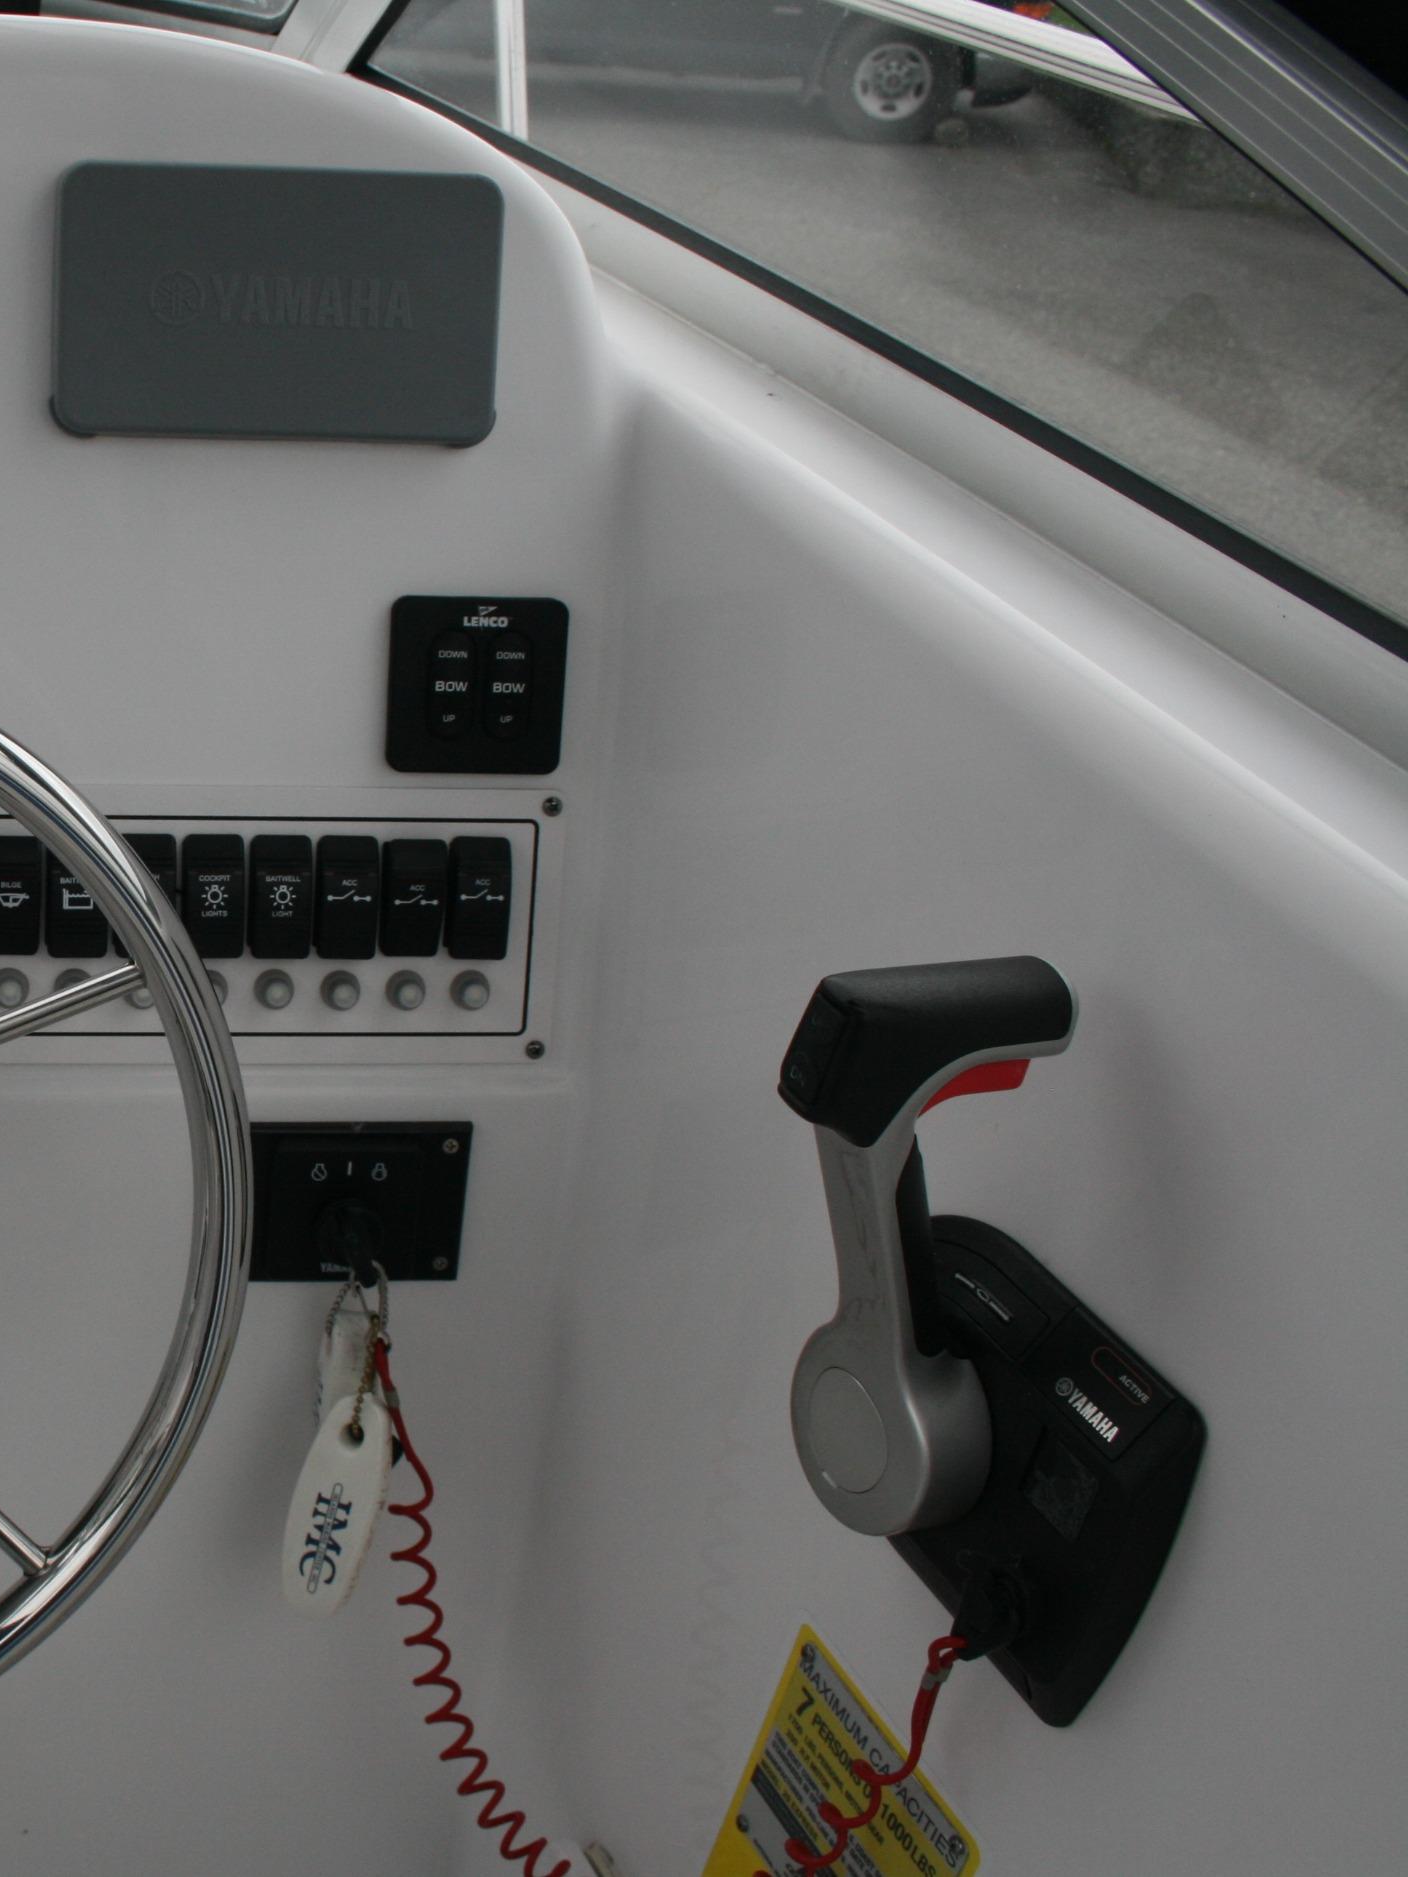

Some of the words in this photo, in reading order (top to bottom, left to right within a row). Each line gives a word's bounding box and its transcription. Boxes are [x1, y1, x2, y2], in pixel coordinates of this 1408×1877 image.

[210, 274, 414, 329] YAMAHA
[462, 616, 509, 628] LENCO
[438, 650, 468, 659] DOWN
[496, 651, 525, 660] DOWN
[434, 681, 468, 692] BOW
[492, 682, 525, 694] BOW
[442, 715, 456, 723] UP
[499, 715, 513, 724] UP
[0, 881, 21, 889] BILGE
[342, 879, 358, 887] ACC
[474, 878, 491, 886] ACC
[410, 884, 426, 892] ACC
[1119, 1374, 1152, 1404] ACTIVE
[1067, 1388, 1121, 1443] YAMAHA
[799, 1659, 869, 1749] MAXIMUM
[870, 1748, 958, 1868] CAACITIES
[794, 1687, 815, 1717] 7
[880, 1803, 913, 1851] 1000
